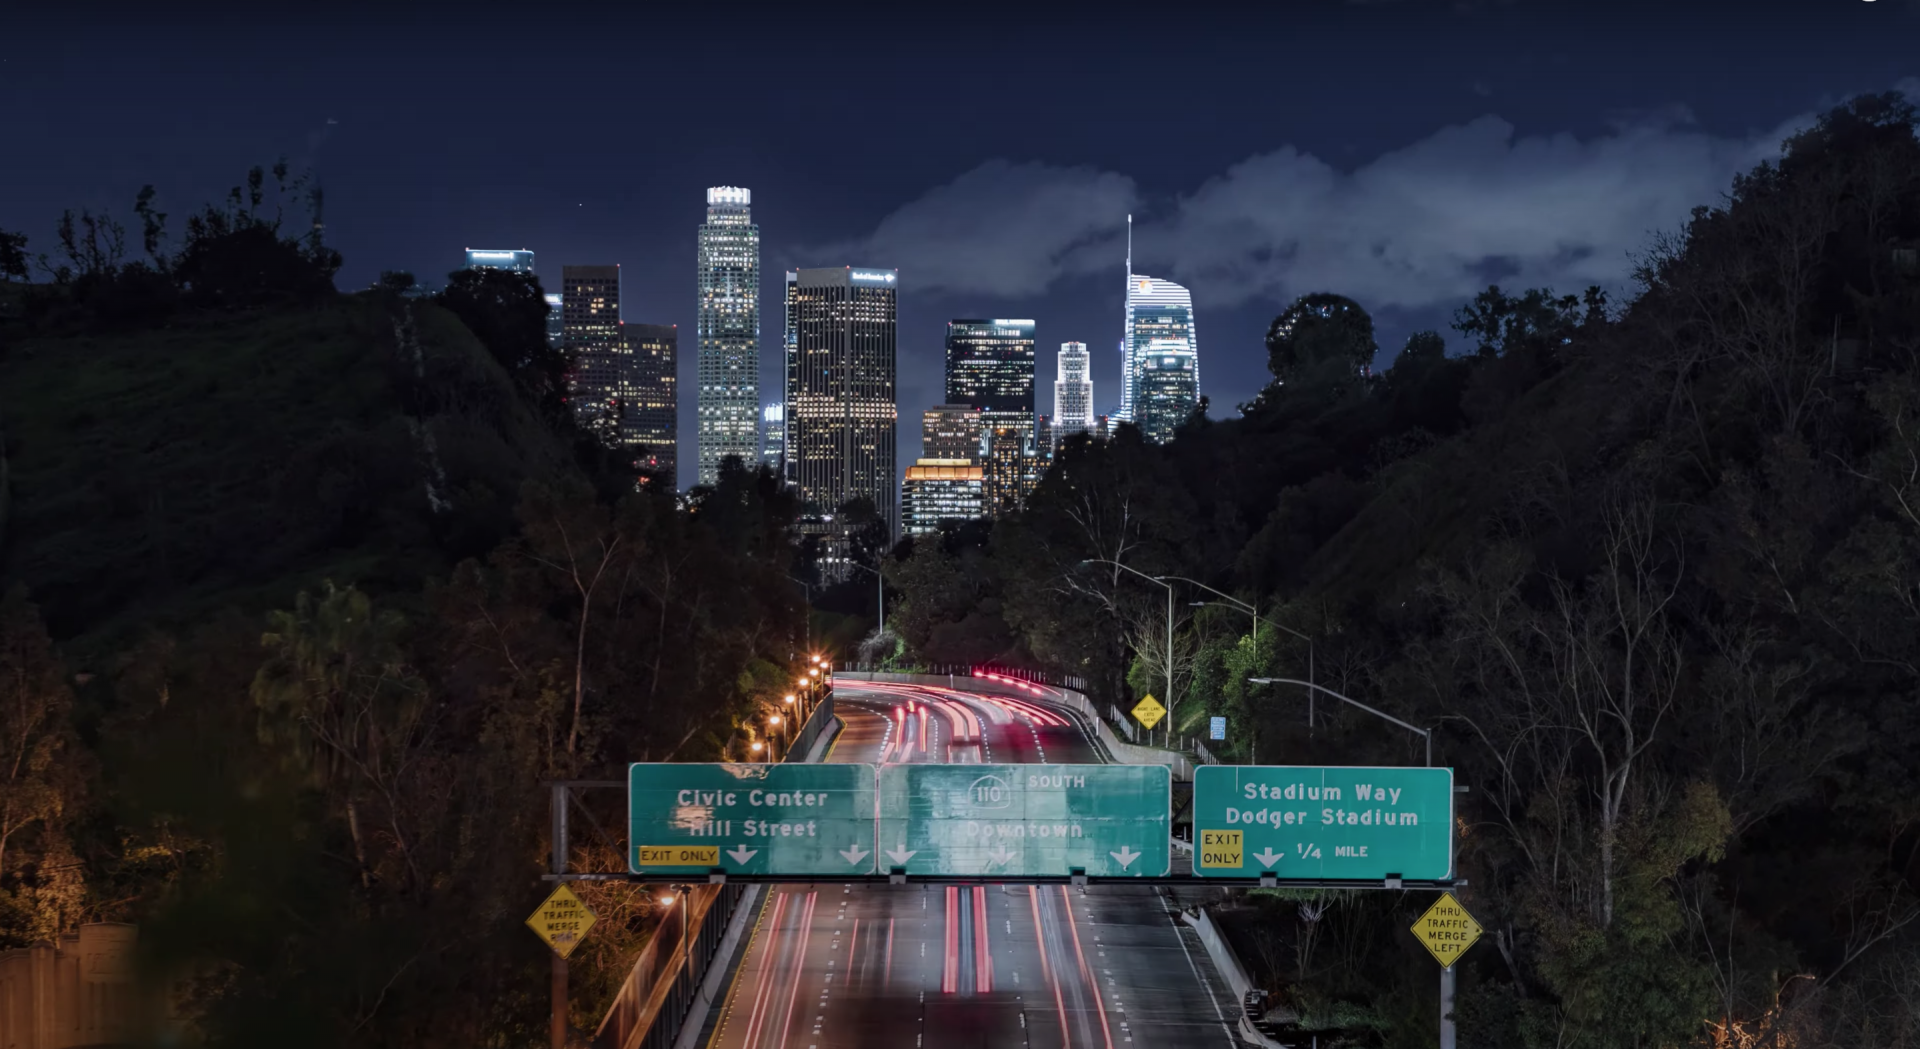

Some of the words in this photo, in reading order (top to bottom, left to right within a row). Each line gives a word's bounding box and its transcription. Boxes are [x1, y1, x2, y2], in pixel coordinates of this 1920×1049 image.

[1028, 774, 1085, 788] SOUTH
[677, 789, 737, 806] Civic
[749, 789, 828, 806] Center
[977, 786, 1001, 802] 110
[1244, 782, 1341, 801] Stadium
[1355, 784, 1402, 806] Way
[1226, 807, 1308, 830] Dodger
[1321, 808, 1418, 826] Stadium
[690, 820, 731, 837] Hill
[743, 819, 816, 837] Street
[967, 821, 1083, 838] Downtown
[1204, 834, 1240, 845] EXIT
[641, 850, 673, 861] EXIT
[680, 850, 717, 861] ONLY
[1297, 843, 1322, 860] 1/4
[1335, 846, 1369, 858] MILE
[1203, 852, 1240, 864] ONLY
[550, 899, 577, 909] THRU
[543, 910, 585, 920] TRAFFIC
[1435, 907, 1461, 917] THRU
[547, 921, 580, 931] MERGE
[1427, 918, 1469, 929] TRAFFIC
[1428, 931, 1468, 941] MERGE
[1434, 943, 1462, 953] LEFT
